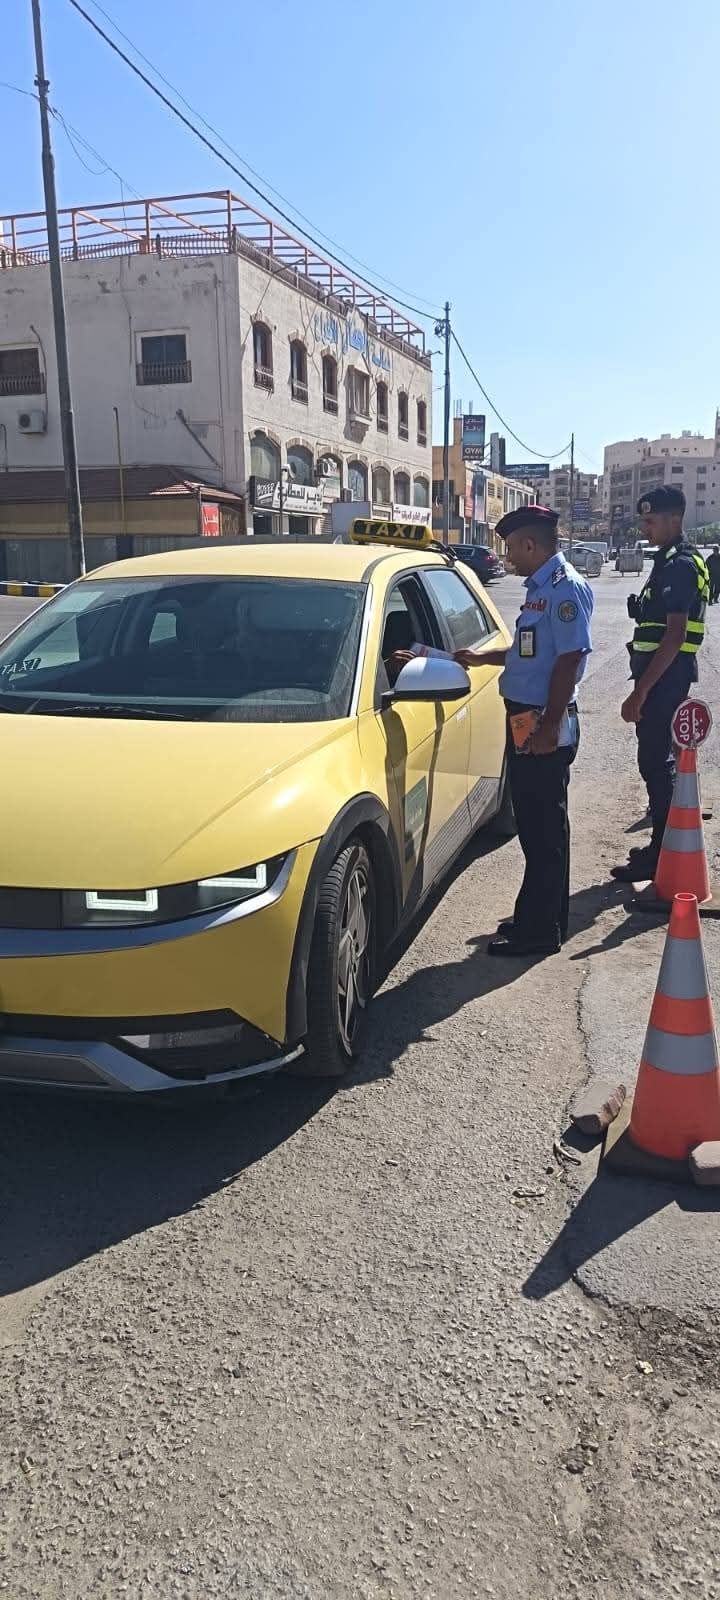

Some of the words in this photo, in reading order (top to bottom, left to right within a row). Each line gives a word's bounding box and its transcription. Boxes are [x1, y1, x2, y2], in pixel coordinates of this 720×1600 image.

[364, 521, 416, 538] TAXI
[1, 658, 38, 675] TAXI
[679, 709, 690, 741] STOP
